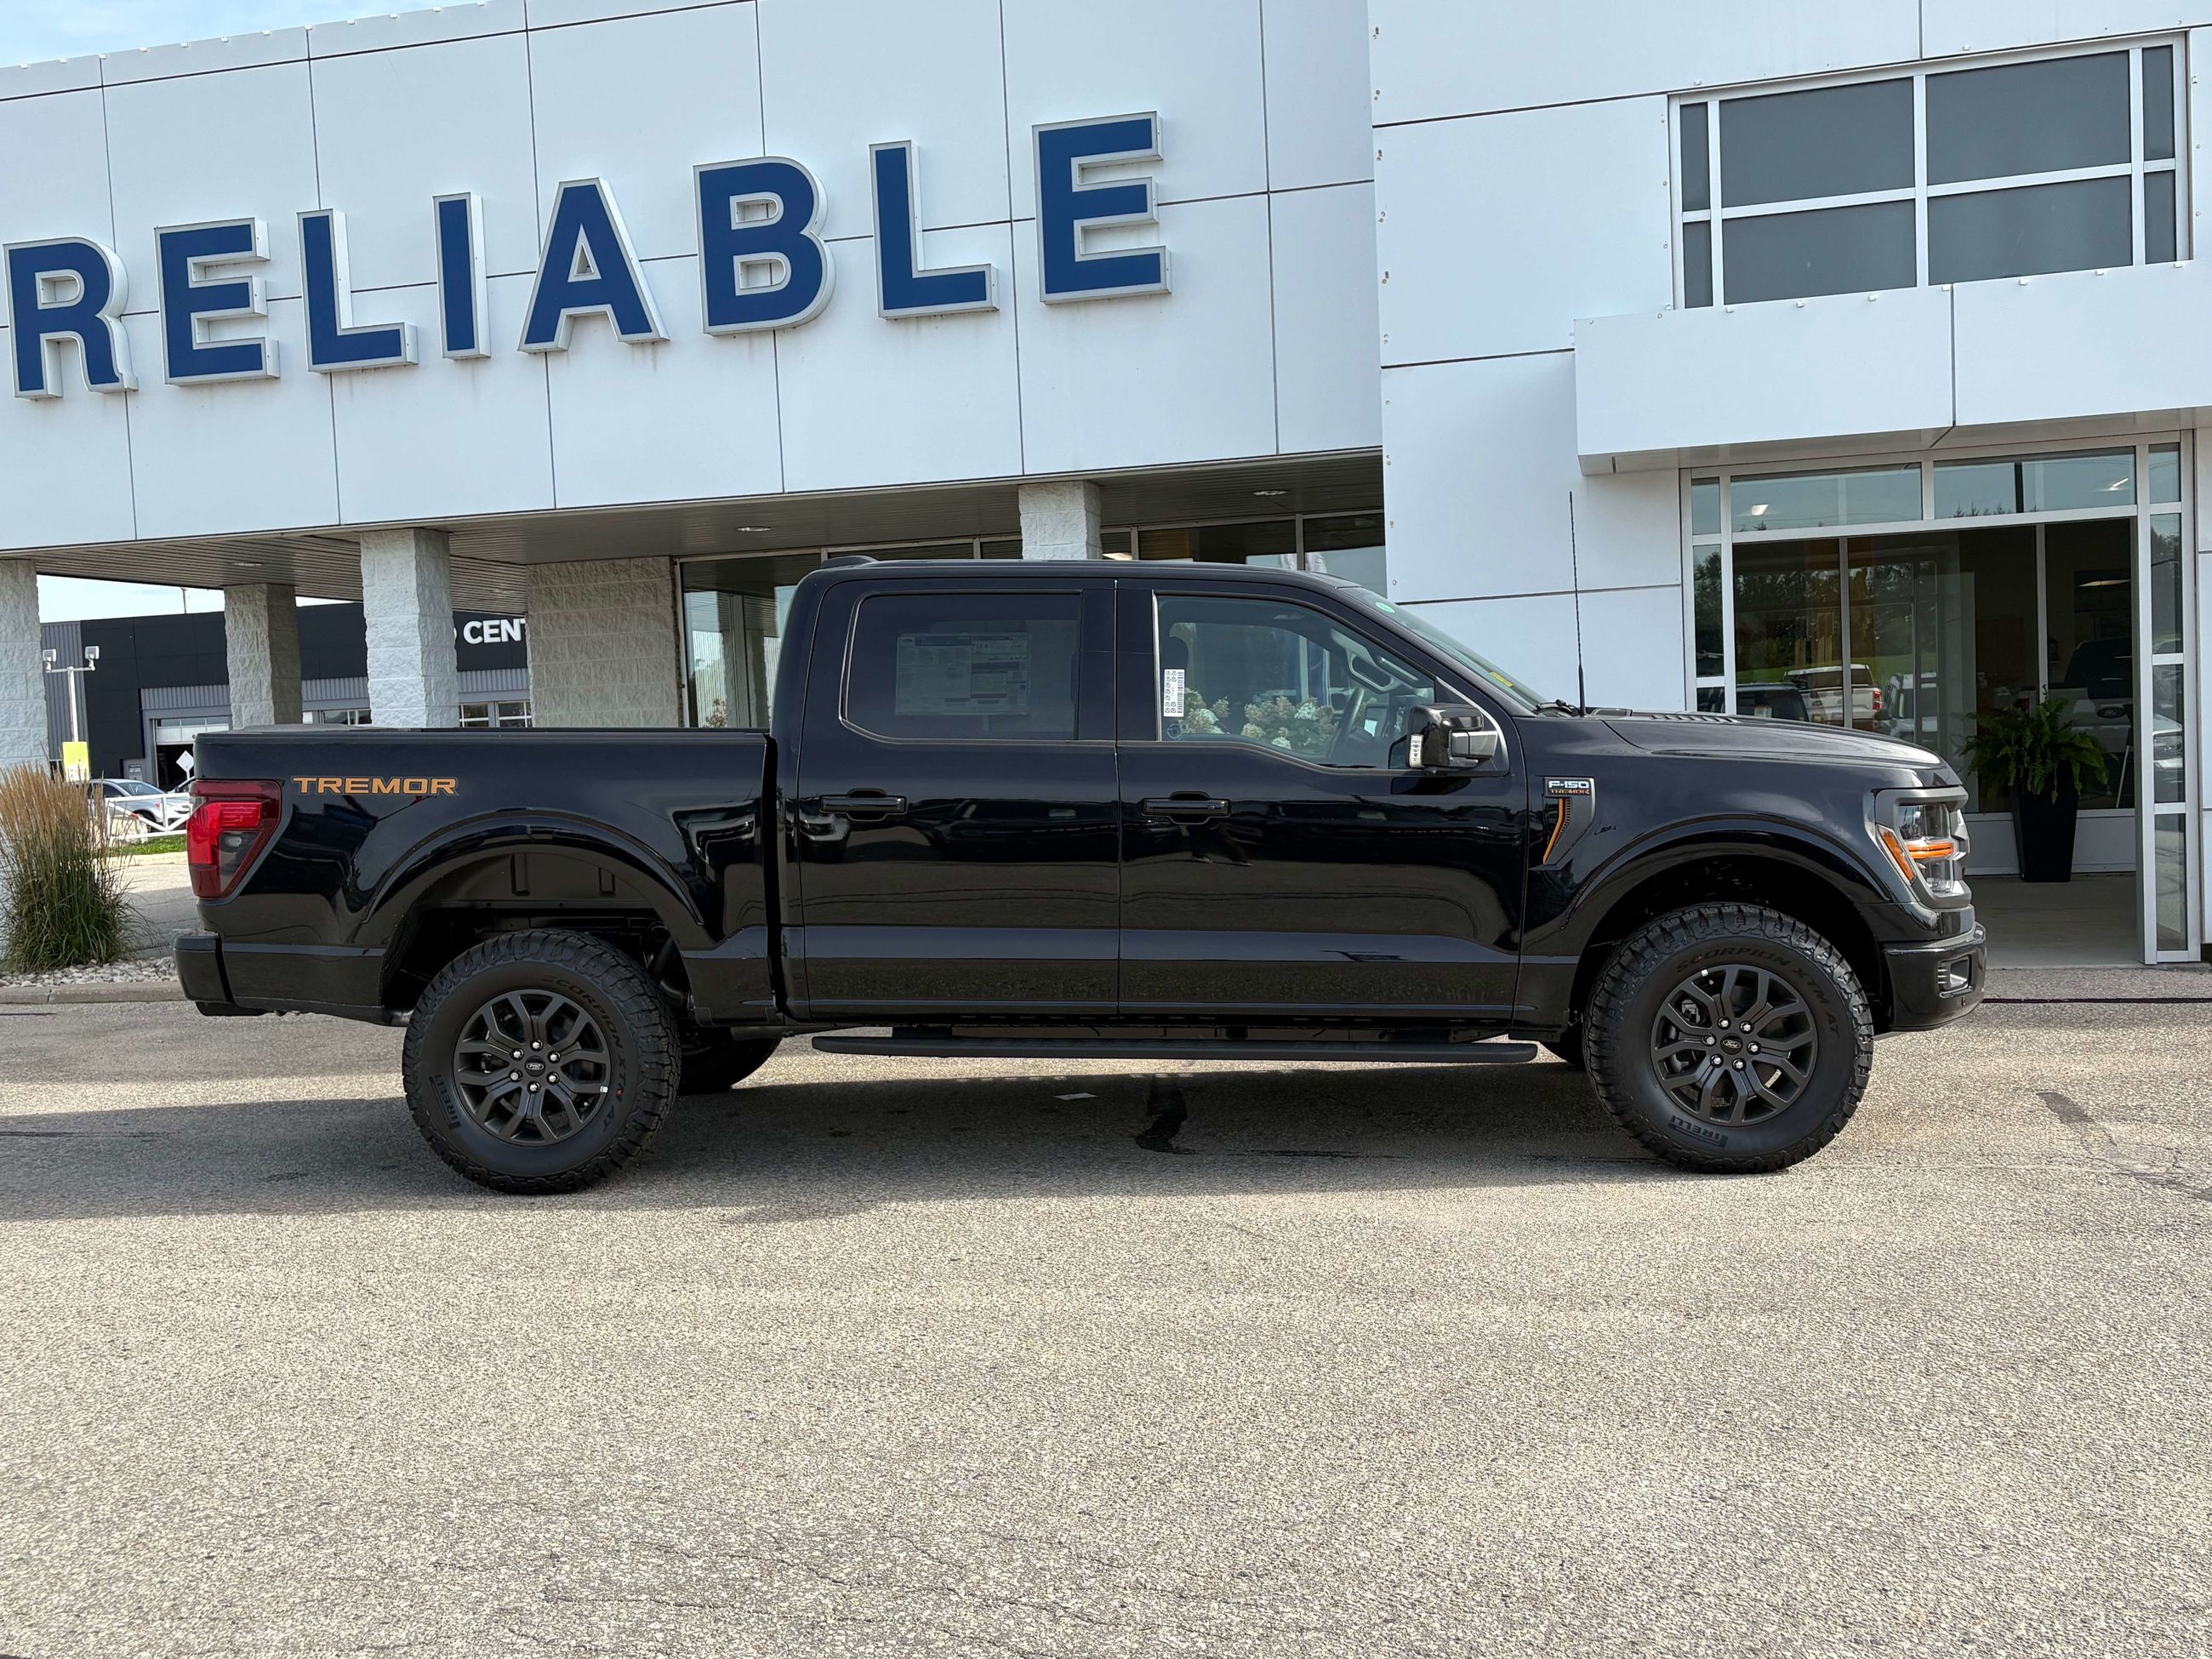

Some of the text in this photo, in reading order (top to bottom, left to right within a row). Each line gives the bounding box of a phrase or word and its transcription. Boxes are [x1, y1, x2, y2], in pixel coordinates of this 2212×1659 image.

[3, 111, 1172, 401] RELIABLE
[292, 776, 459, 795] TREMOR
[1548, 780, 1589, 789] F-150
[1675, 947, 1792, 973] SCORPION
[1668, 1115, 1729, 1149] PIRELLI
